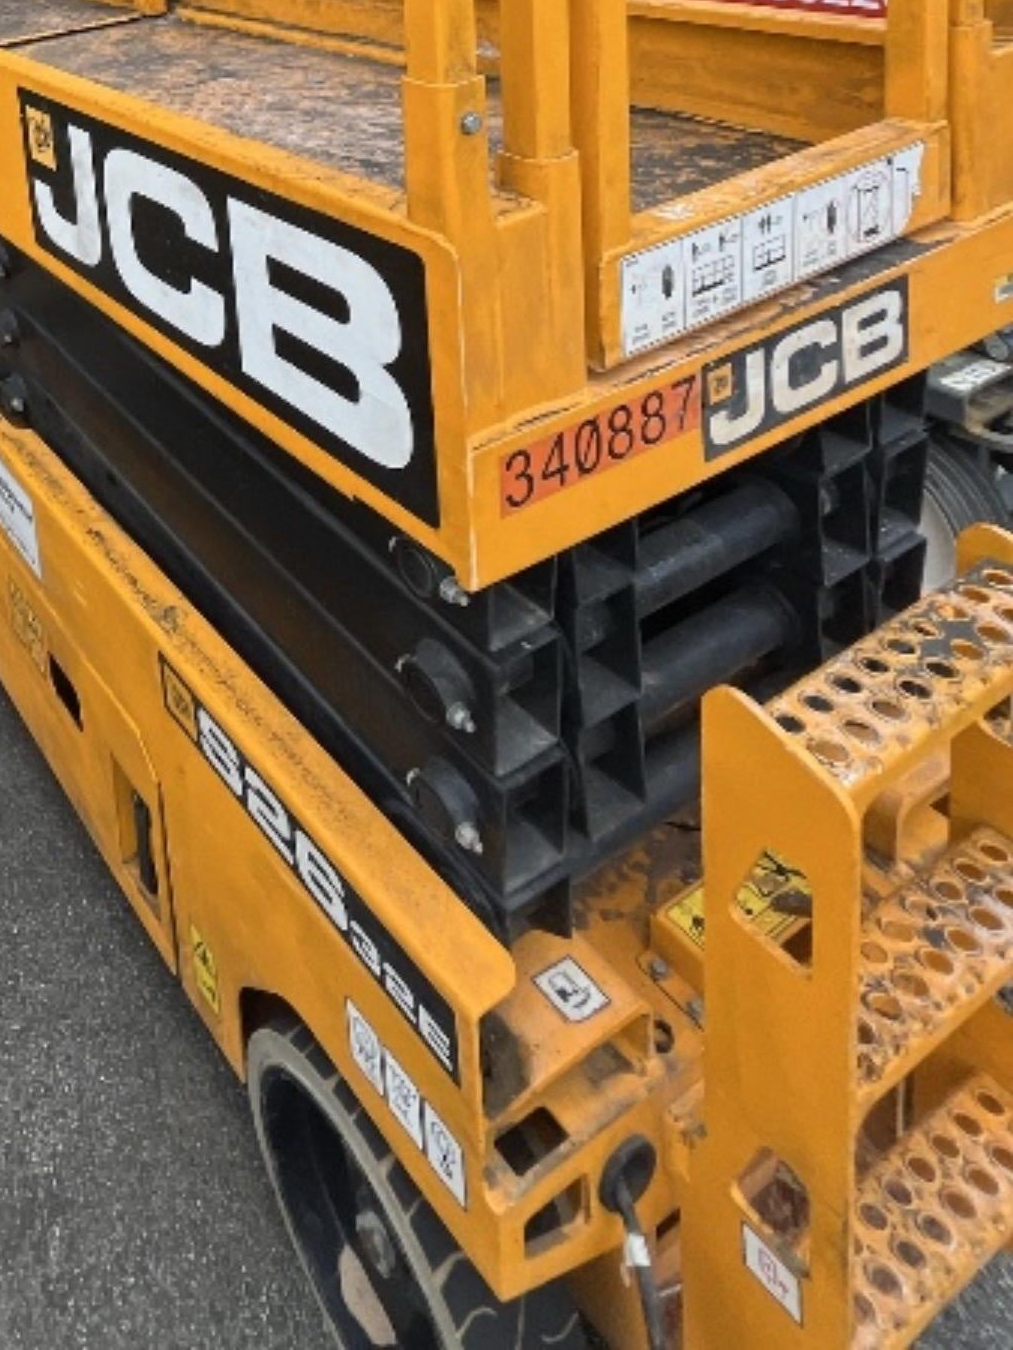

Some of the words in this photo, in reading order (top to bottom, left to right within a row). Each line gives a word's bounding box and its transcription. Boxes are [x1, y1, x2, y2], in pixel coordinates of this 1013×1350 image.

[34, 124, 414, 469] JCB
[710, 290, 903, 446] JCB
[505, 375, 697, 509] 340887
